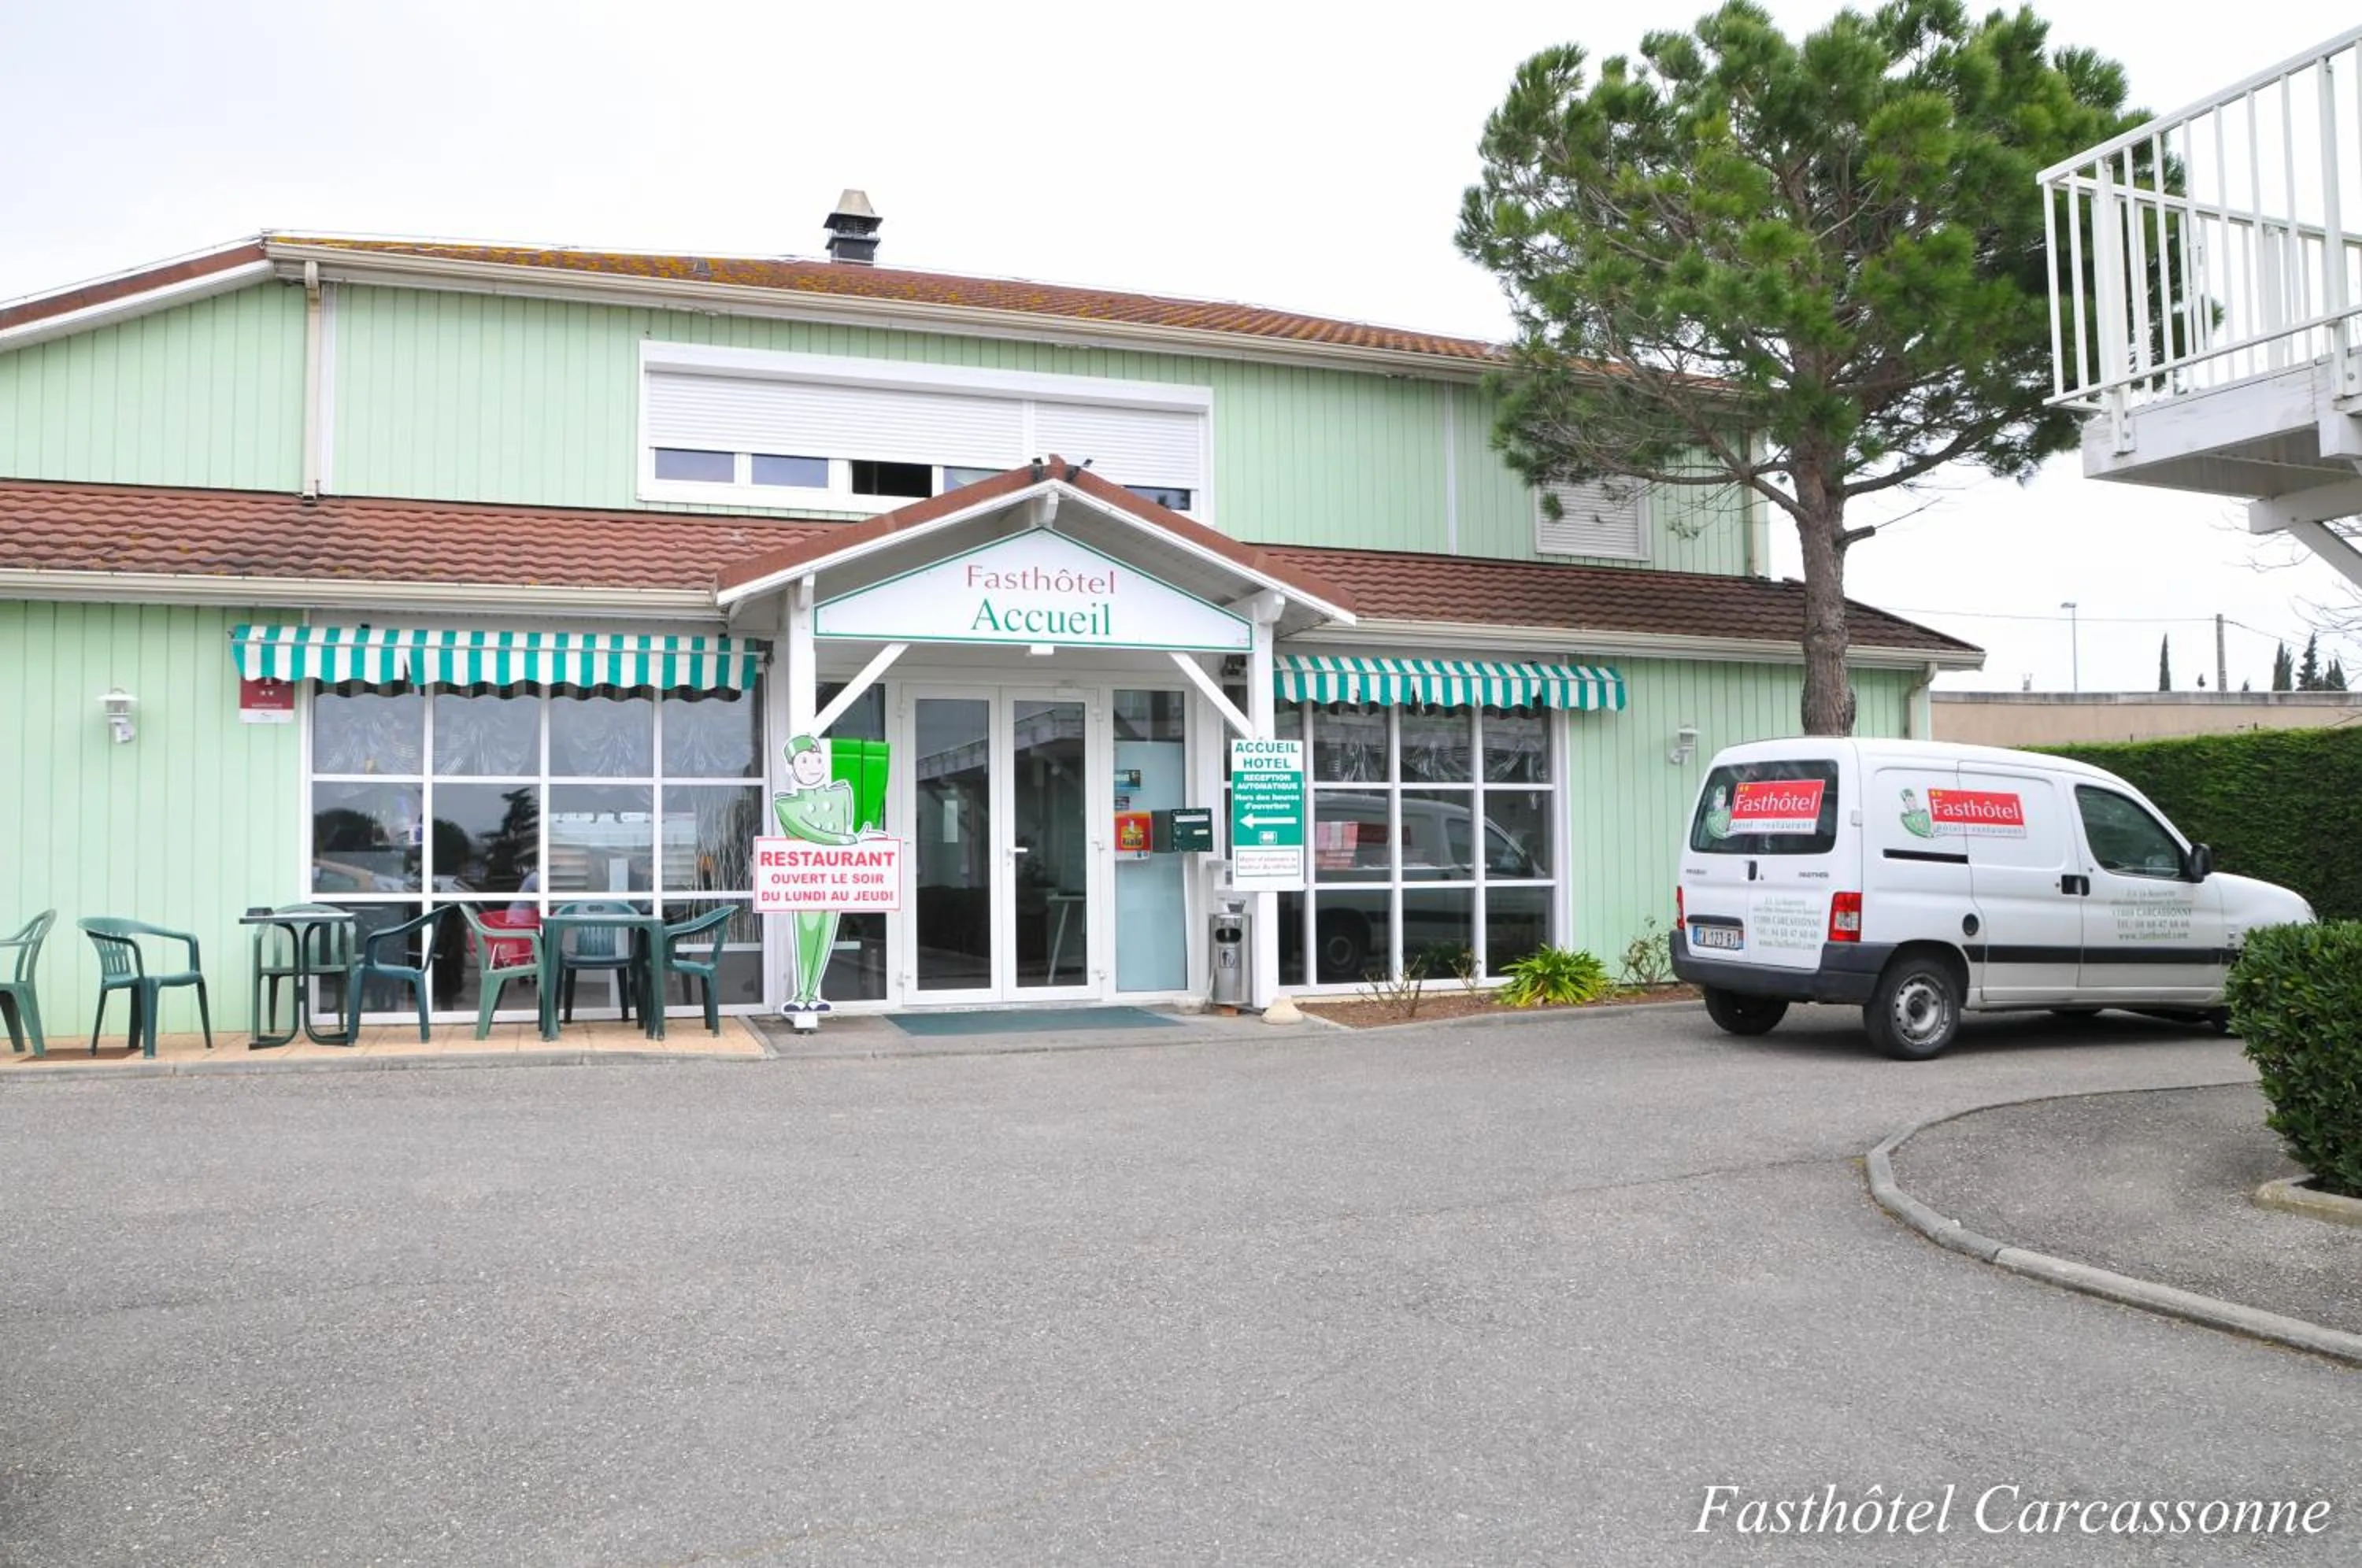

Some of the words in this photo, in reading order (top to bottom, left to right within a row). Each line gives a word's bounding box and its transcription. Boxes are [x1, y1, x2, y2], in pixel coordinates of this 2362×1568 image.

[967, 564, 1115, 594] Fasthôtel
[971, 597, 1113, 636] Accueil
[1235, 741, 1298, 753] ACCUEIL
[1243, 758, 1291, 769] HOTEL
[1237, 782, 1298, 790] AUTOMATIQUE
[1734, 790, 1818, 812] Fasthôtel
[1932, 799, 2020, 819] Fasthôtel
[760, 851, 895, 867] RESTAURANT
[771, 873, 827, 884] OUVERT
[831, 873, 848, 884] LE
[852, 873, 884, 884] SOIR
[761, 890, 780, 901] DU
[785, 890, 827, 901] LUNDI
[831, 890, 850, 901] AU
[853, 890, 894, 901] JEUDI
